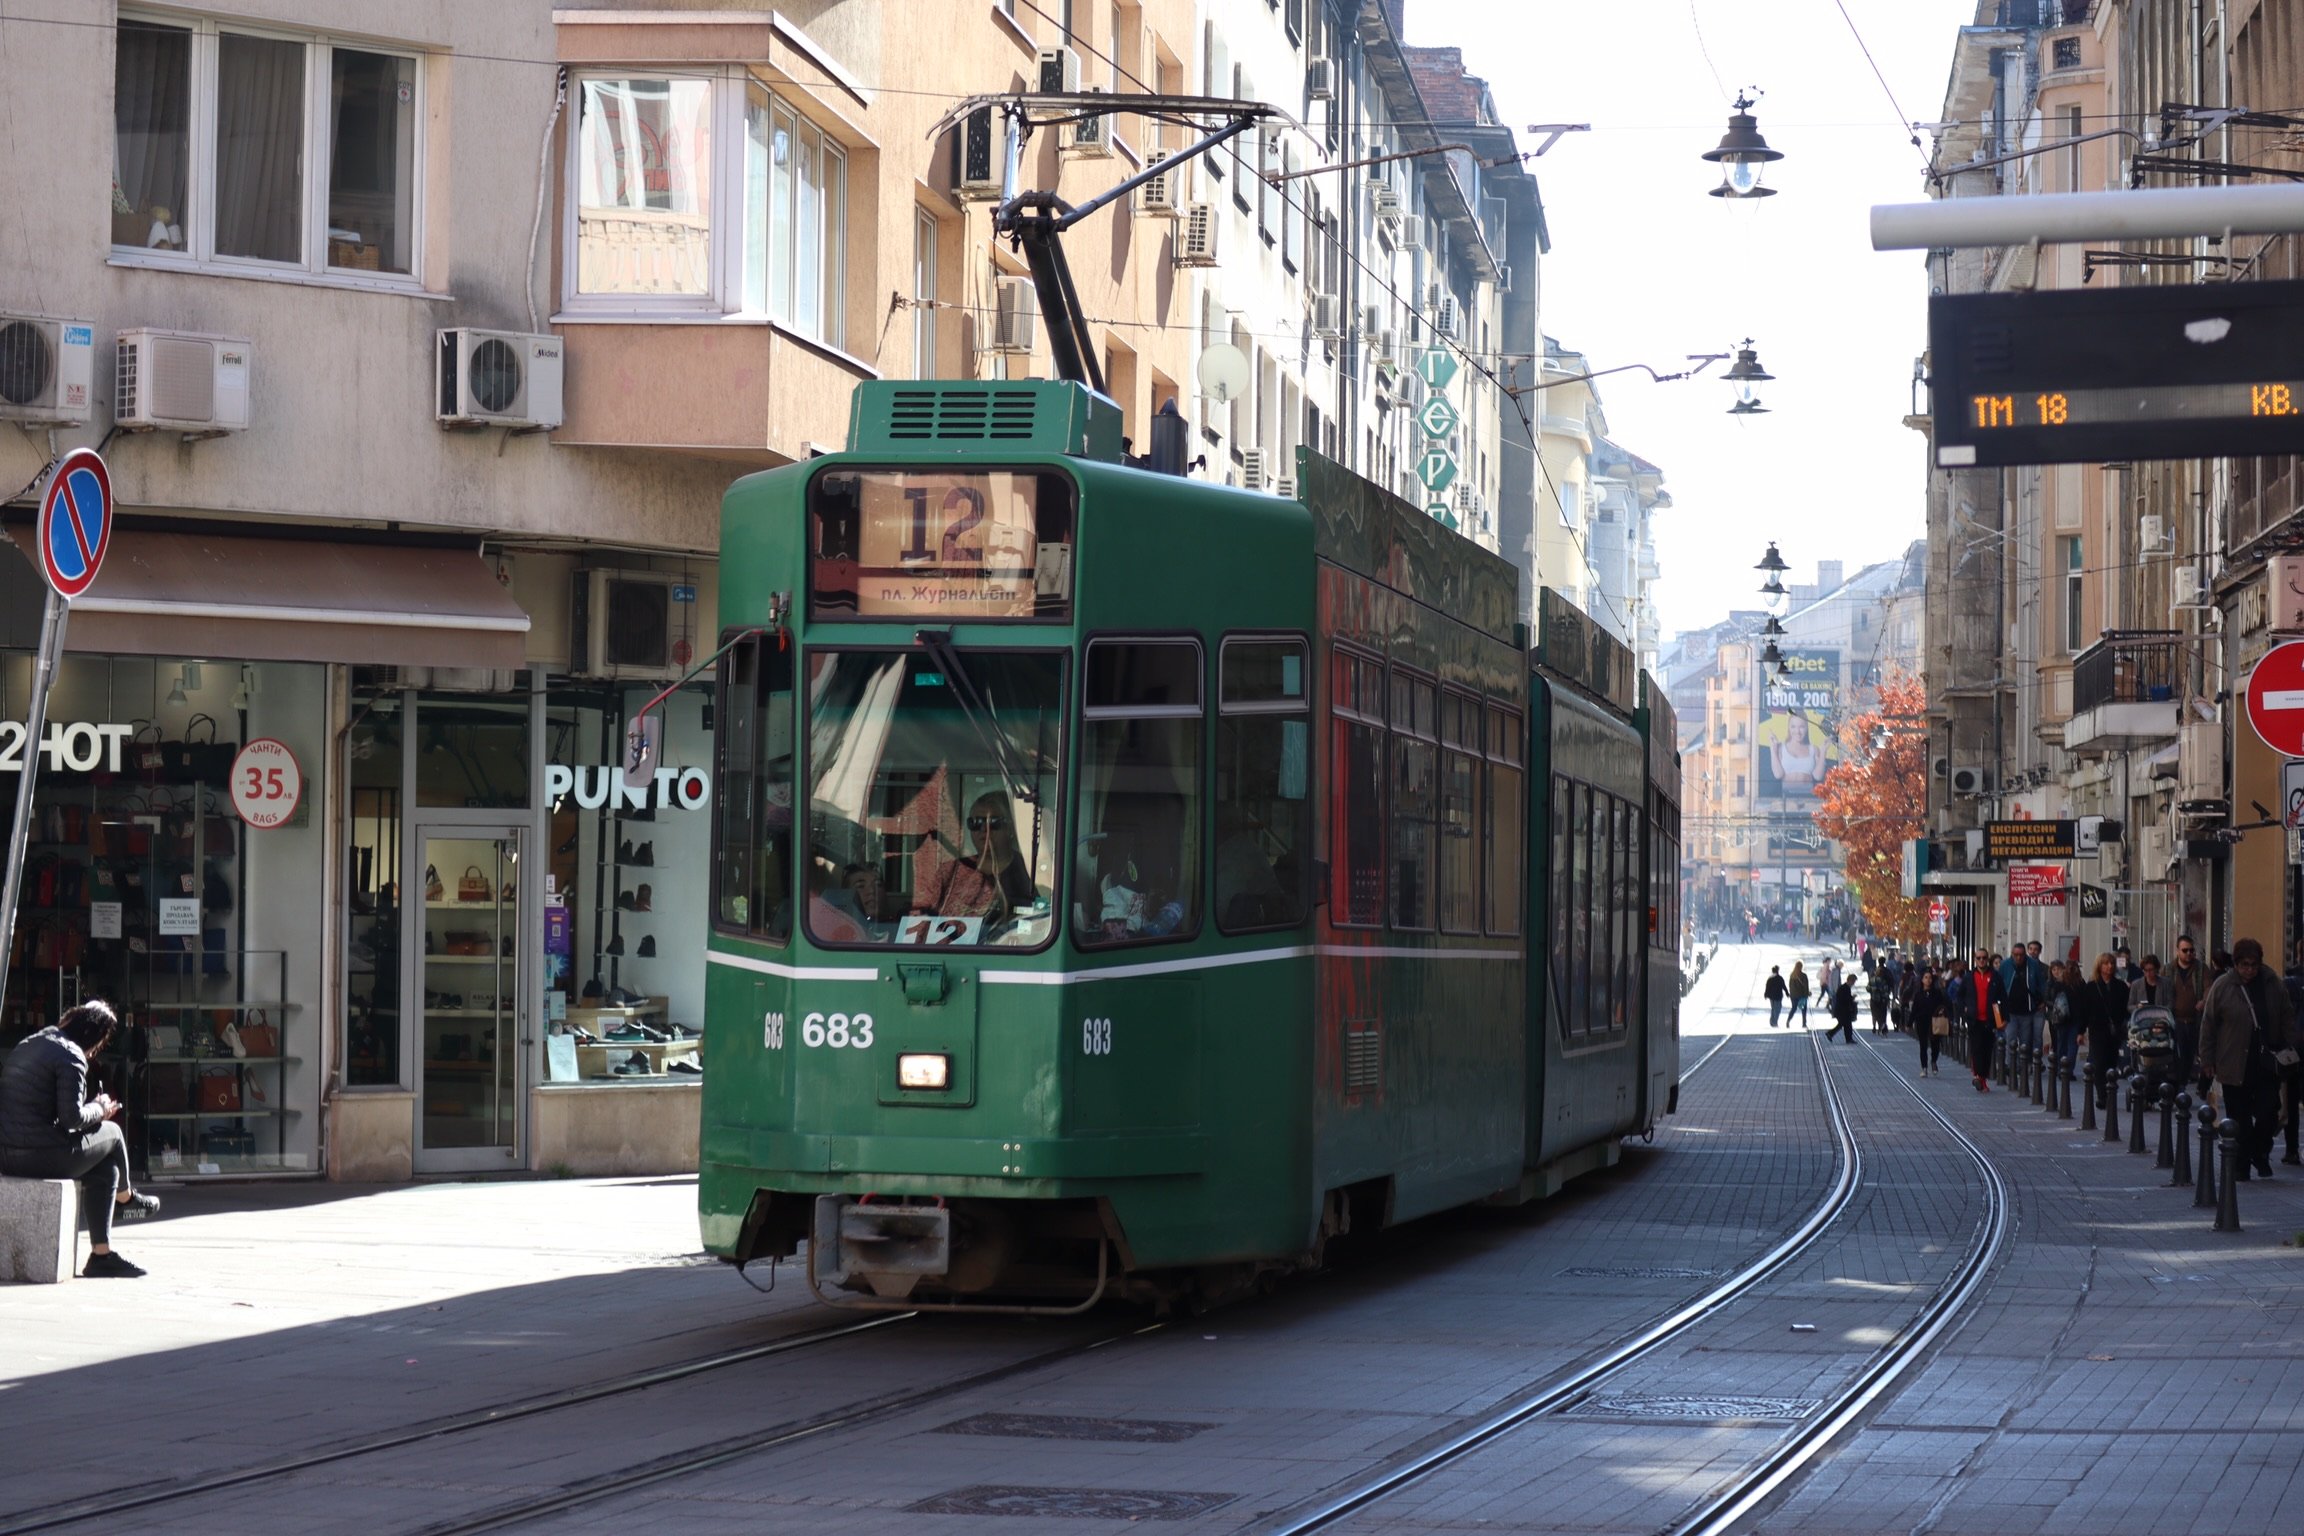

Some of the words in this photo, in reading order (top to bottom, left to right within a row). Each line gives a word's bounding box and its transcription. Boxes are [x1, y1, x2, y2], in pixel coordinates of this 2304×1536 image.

[222, 354, 242, 365] Ferroli
[2036, 394, 2068, 425] 18
[901, 486, 986, 562] 12
[1785, 655, 1827, 672] fbet
[249, 743, 283, 757] ЧАНТИ
[245, 766, 283, 800] 35
[545, 764, 711, 811] PUNTO
[252, 812, 278, 824] BAGS
[1990, 824, 2057, 834] ЕКСПРЕСНИ
[1990, 835, 2044, 845] ПРЕВОДИ
[2047, 836, 2055, 845] И
[1990, 846, 2073, 857] ЛЕГАЛИЗАЦИЯ
[2013, 896, 2060, 906] МИКЕНА
[905, 919, 968, 945] 12
[764, 1012, 784, 1050] 683
[802, 1012, 874, 1049] 683
[1083, 1018, 1112, 1055] 683
